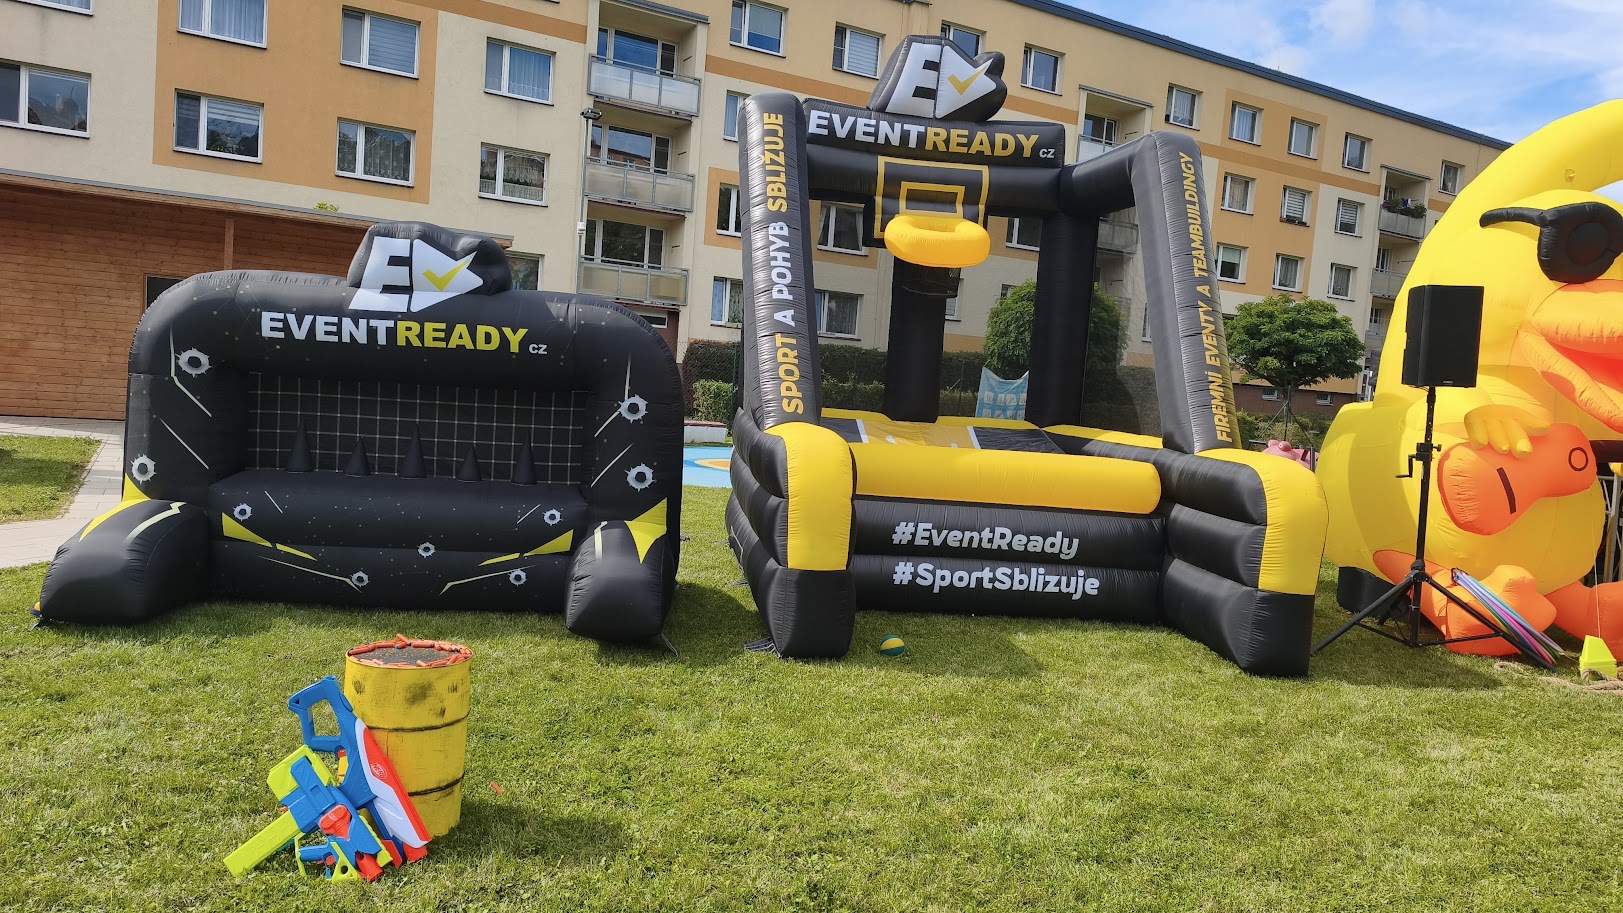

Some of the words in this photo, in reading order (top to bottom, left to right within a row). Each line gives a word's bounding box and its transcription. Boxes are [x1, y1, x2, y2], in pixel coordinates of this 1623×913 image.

[760, 112, 788, 213] SBLIŽUJE
[808, 110, 1039, 158] EVENTREADY
[1039, 148, 1055, 159] CZ
[1179, 151, 1208, 277] TEAMBUILDINGY
[769, 222, 794, 301] POHYB
[774, 309, 796, 327] A
[1196, 285, 1211, 298] A
[261, 311, 528, 353] EVENTREADY
[528, 344, 548, 355] CZ
[1198, 300, 1221, 367] EVENTY
[775, 333, 804, 415] SPORT
[1205, 371, 1232, 442] FIREMNÍ
[892, 521, 1079, 560] #EventReady
[893, 562, 1100, 600] #SportSblizuje
